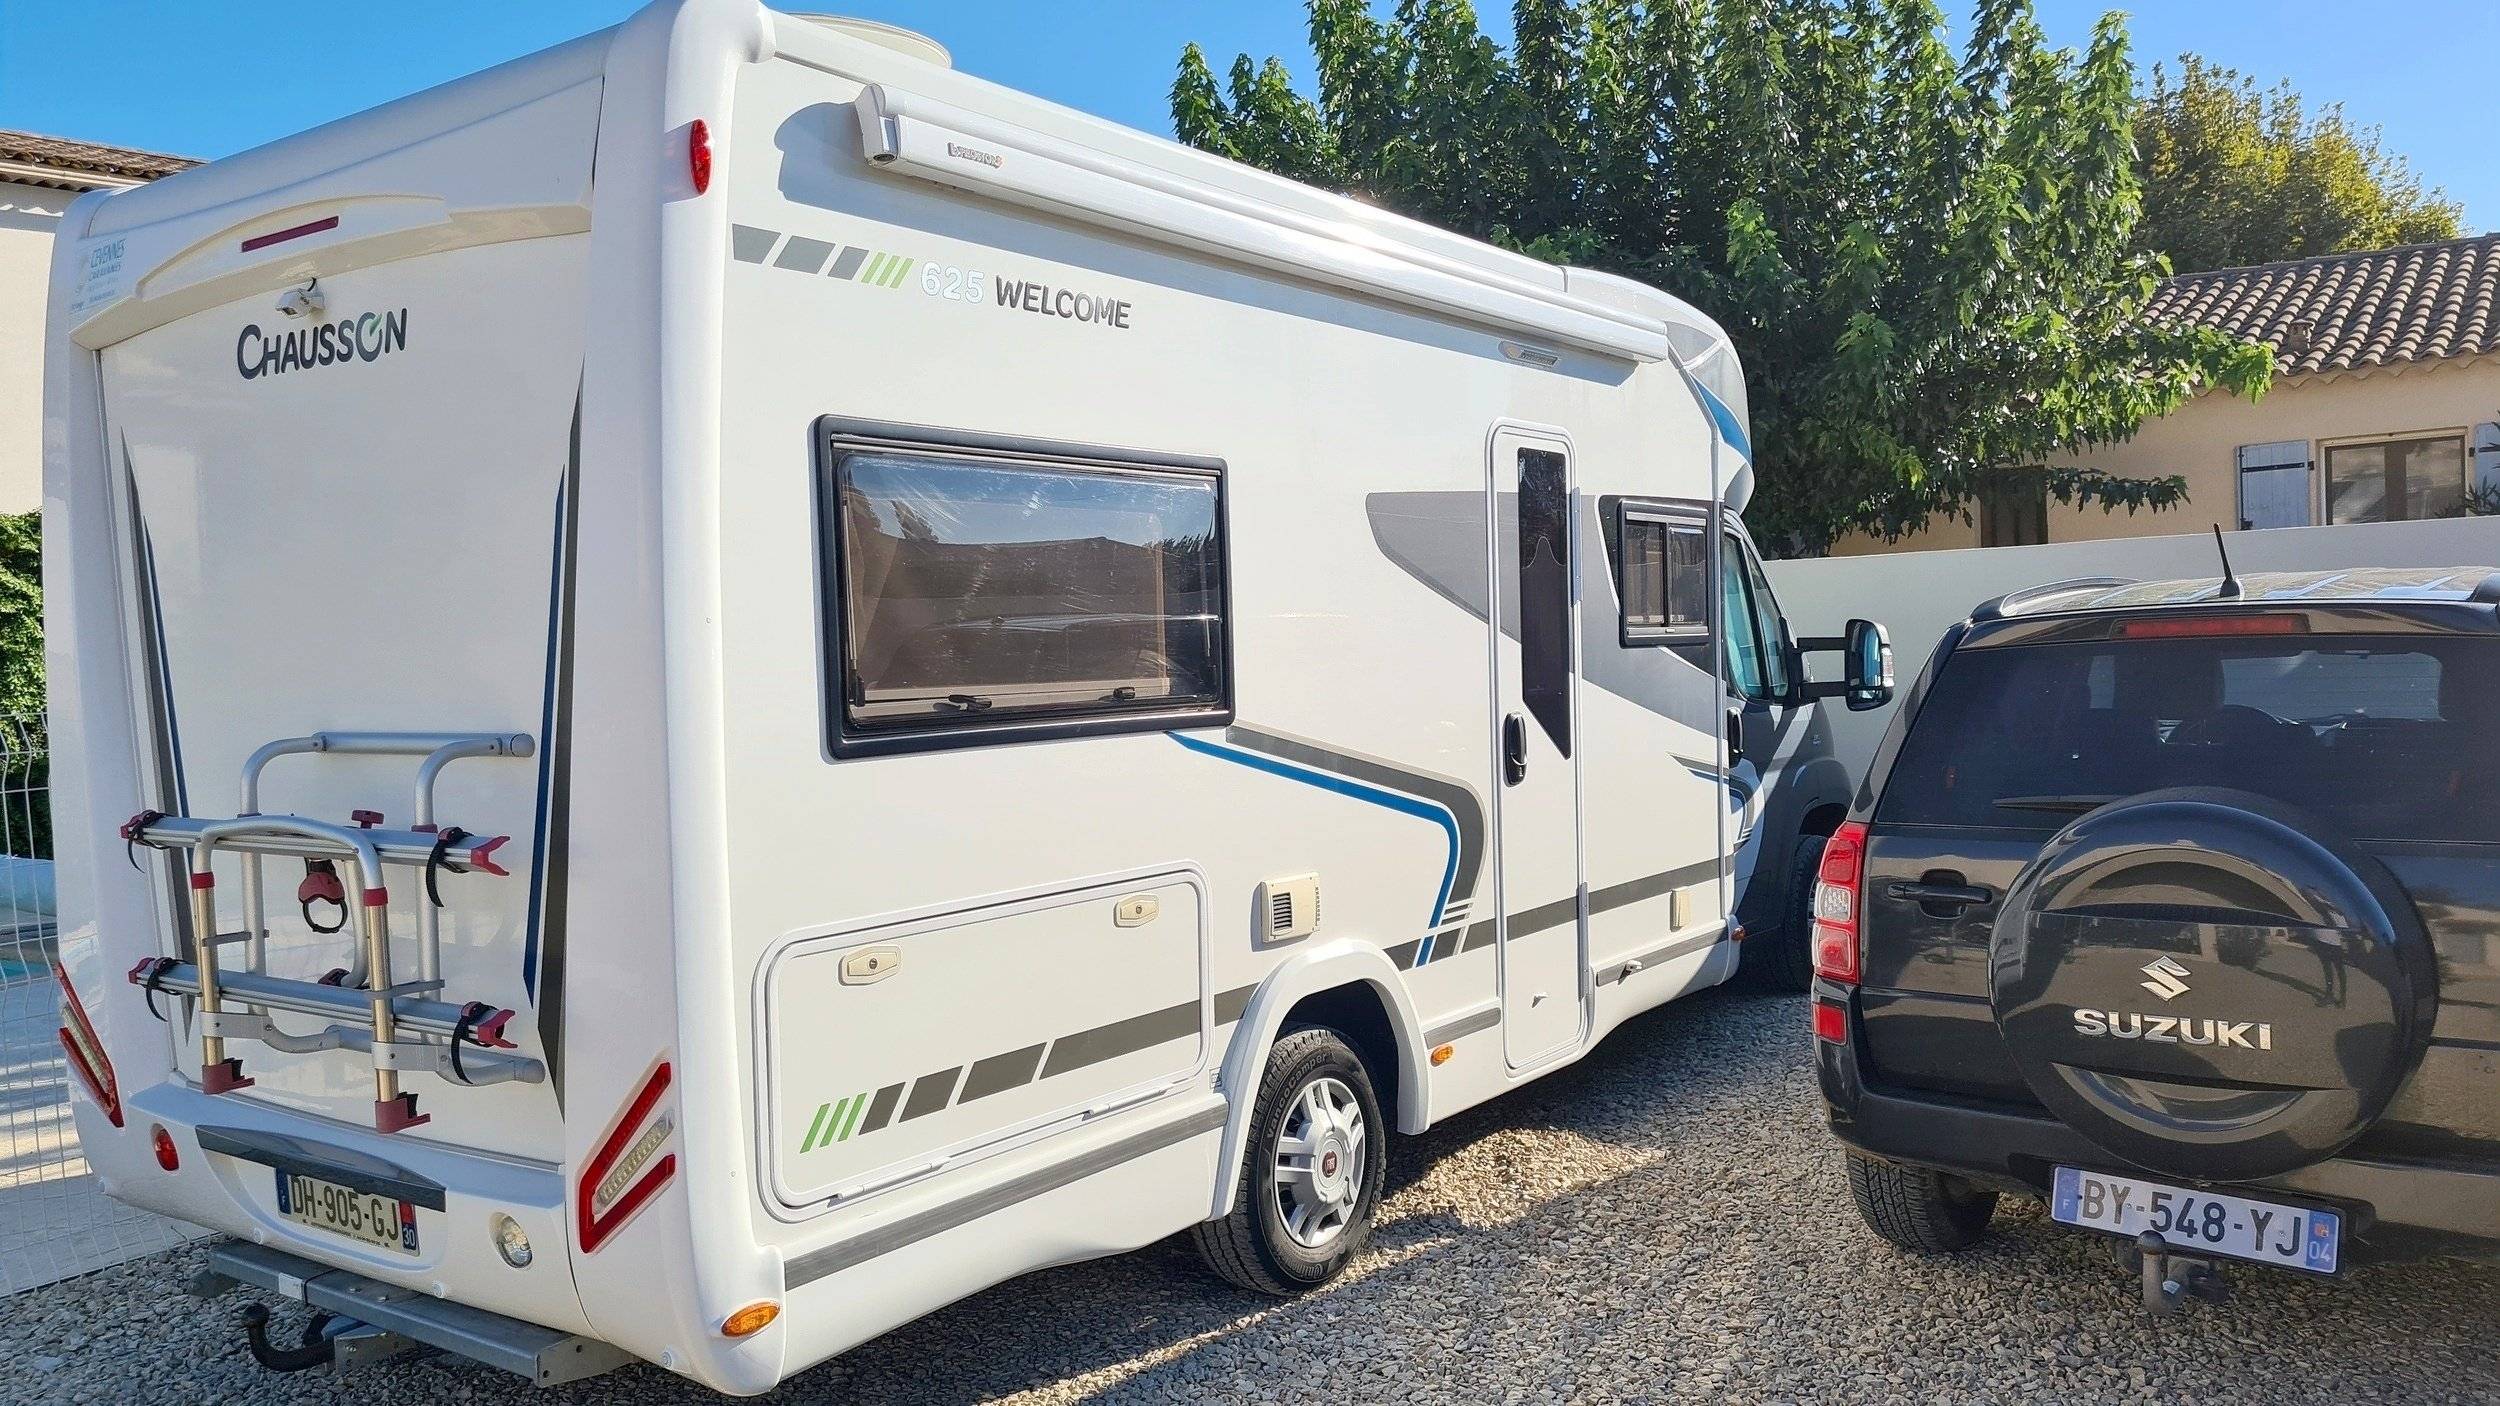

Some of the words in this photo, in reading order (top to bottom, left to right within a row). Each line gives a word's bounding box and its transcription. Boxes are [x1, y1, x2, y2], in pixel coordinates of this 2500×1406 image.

[920, 260, 986, 304] 625
[995, 274, 1132, 329] WELCOME
[237, 307, 408, 380] CHAUSSON
[2072, 1007, 2272, 1051] SUZUKI
[290, 1175, 400, 1241] DH-905-GJ
[402, 1226, 416, 1247] 30
[2061, 1199, 2071, 1211] F
[2081, 1178, 2302, 1257] BY-548-YJ
[2308, 1240, 2332, 1263] 04
